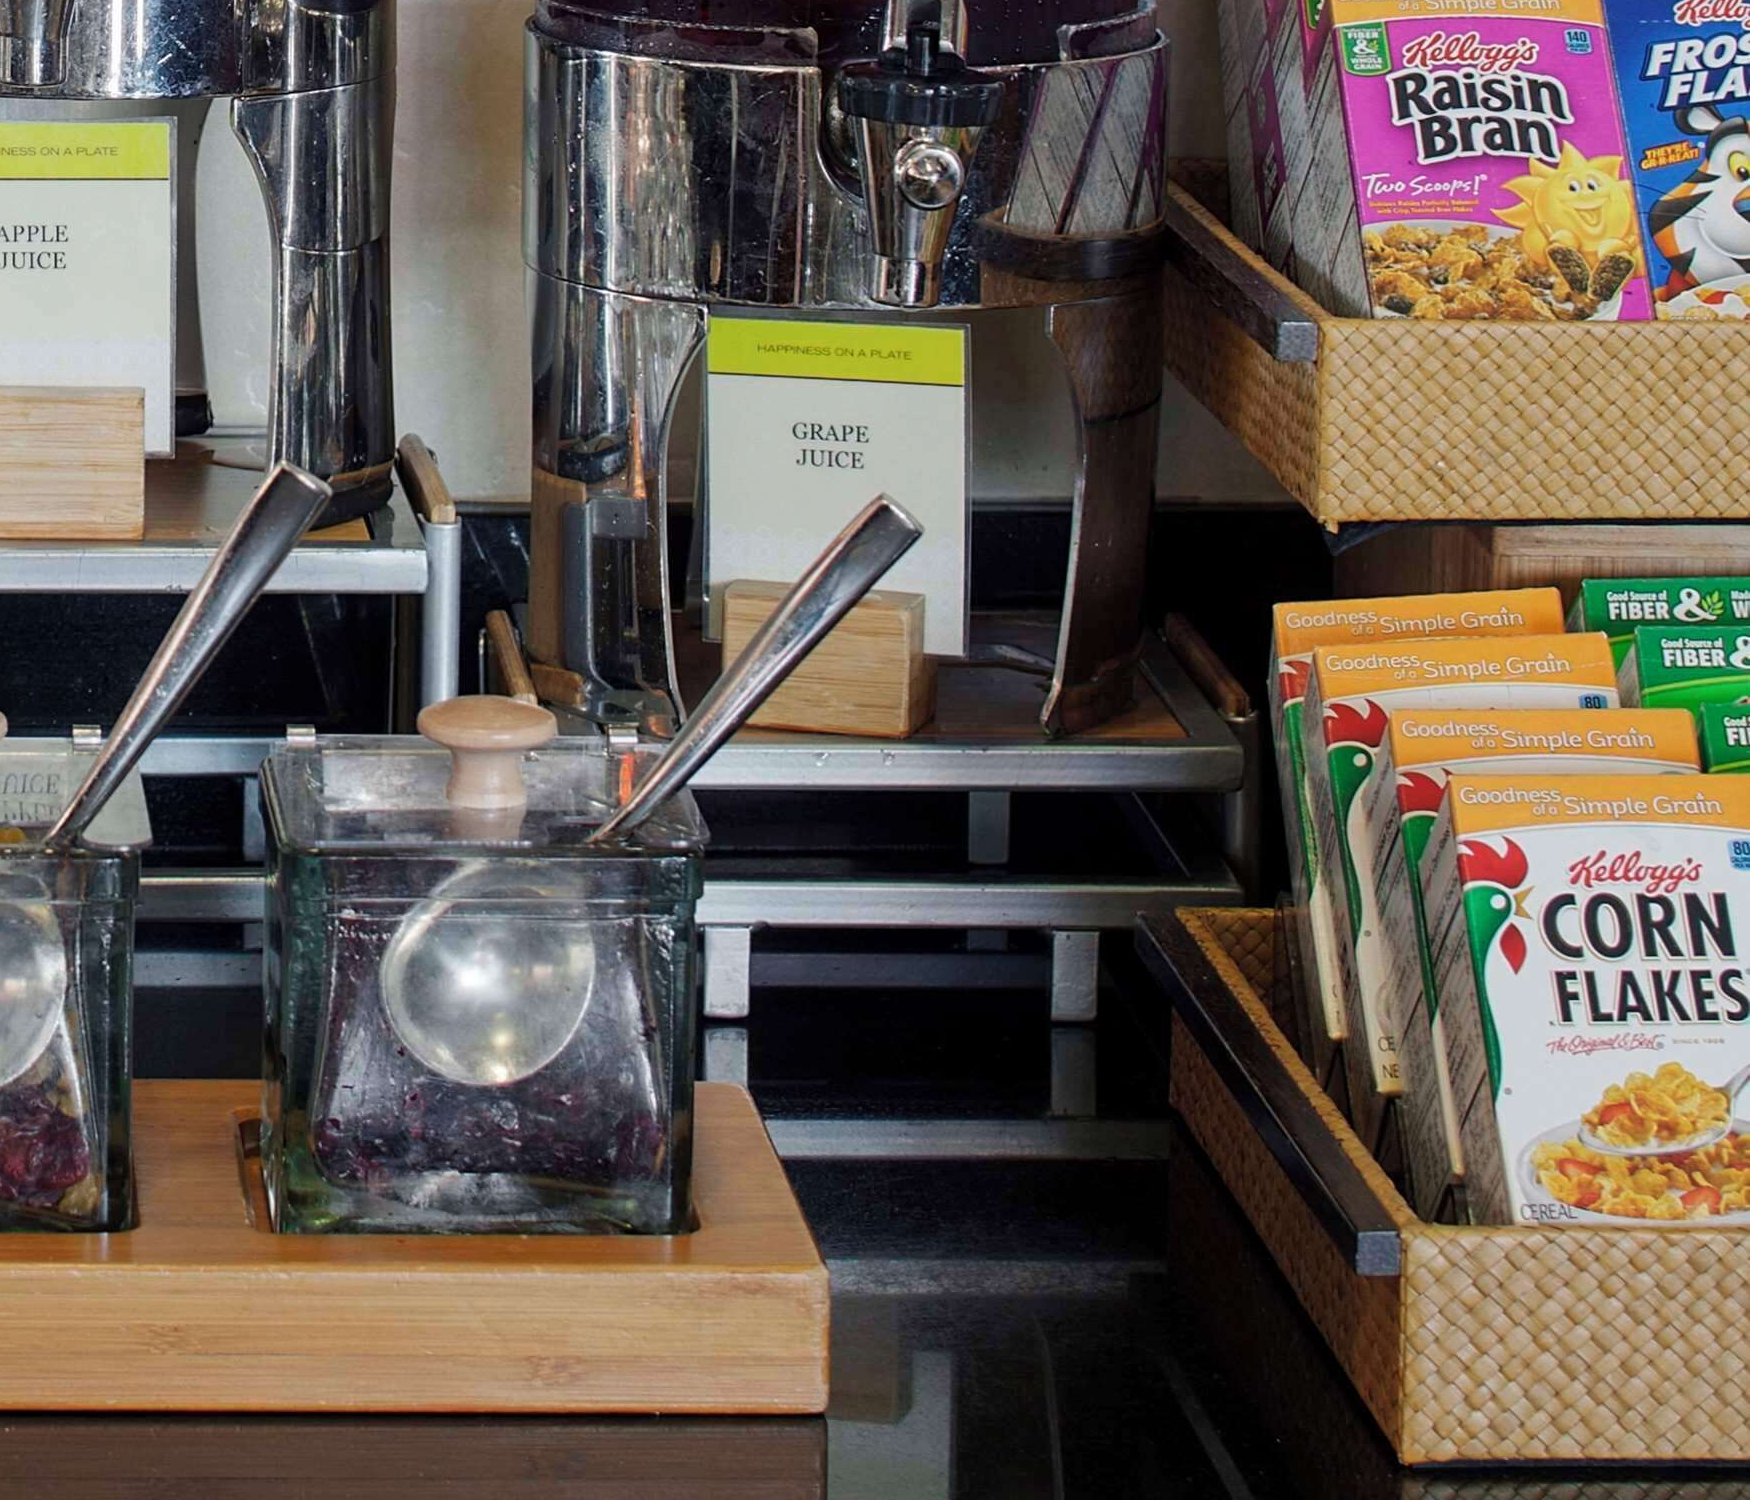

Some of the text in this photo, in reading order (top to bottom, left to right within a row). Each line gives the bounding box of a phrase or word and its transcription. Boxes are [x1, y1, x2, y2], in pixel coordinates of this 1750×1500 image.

[1567, 31, 1587, 42] 140
[1404, 31, 1539, 72] Kellogg's
[1391, 71, 1570, 120] Raisin
[1663, 66, 1750, 107] FLA
[40, 146, 62, 157] ON
[63, 146, 73, 157] A
[75, 146, 119, 157] PLATE
[1418, 115, 1560, 161] Bran
[1362, 173, 1480, 198] Two Scoops!
[756, 344, 913, 361] HAPPINESS ON A PLATE
[791, 422, 870, 443] GRAPE
[796, 449, 865, 470] JUICE
[1607, 591, 1629, 601] Good
[1630, 591, 1656, 601] Source
[1608, 588, 1717, 622] FIBER &
[1285, 611, 1378, 630] Goodness
[1379, 614, 1456, 636] Simple
[1460, 607, 1524, 630] Grain
[1661, 638, 1683, 648] Good
[1326, 653, 1420, 673] Goodness
[1422, 660, 1501, 682] Simple
[1505, 653, 1571, 676] Grain
[1662, 648, 1726, 667] FIBER
[1585, 696, 1601, 708] 80
[1402, 720, 1499, 738] Goodness
[1501, 729, 1582, 753] Simple
[1586, 726, 1654, 749] Grain
[1459, 787, 1562, 804] Goodness
[1564, 796, 1648, 819] Simple
[1650, 792, 1722, 815] Grain
[1569, 850, 1703, 895] Kellogg's
[1542, 892, 1736, 959] CORN
[1553, 969, 1750, 1024] FLAKES
[1545, 1037, 1568, 1054] The
[1568, 1033, 1616, 1055] Original
[1520, 1203, 1577, 1222] CEREAL
